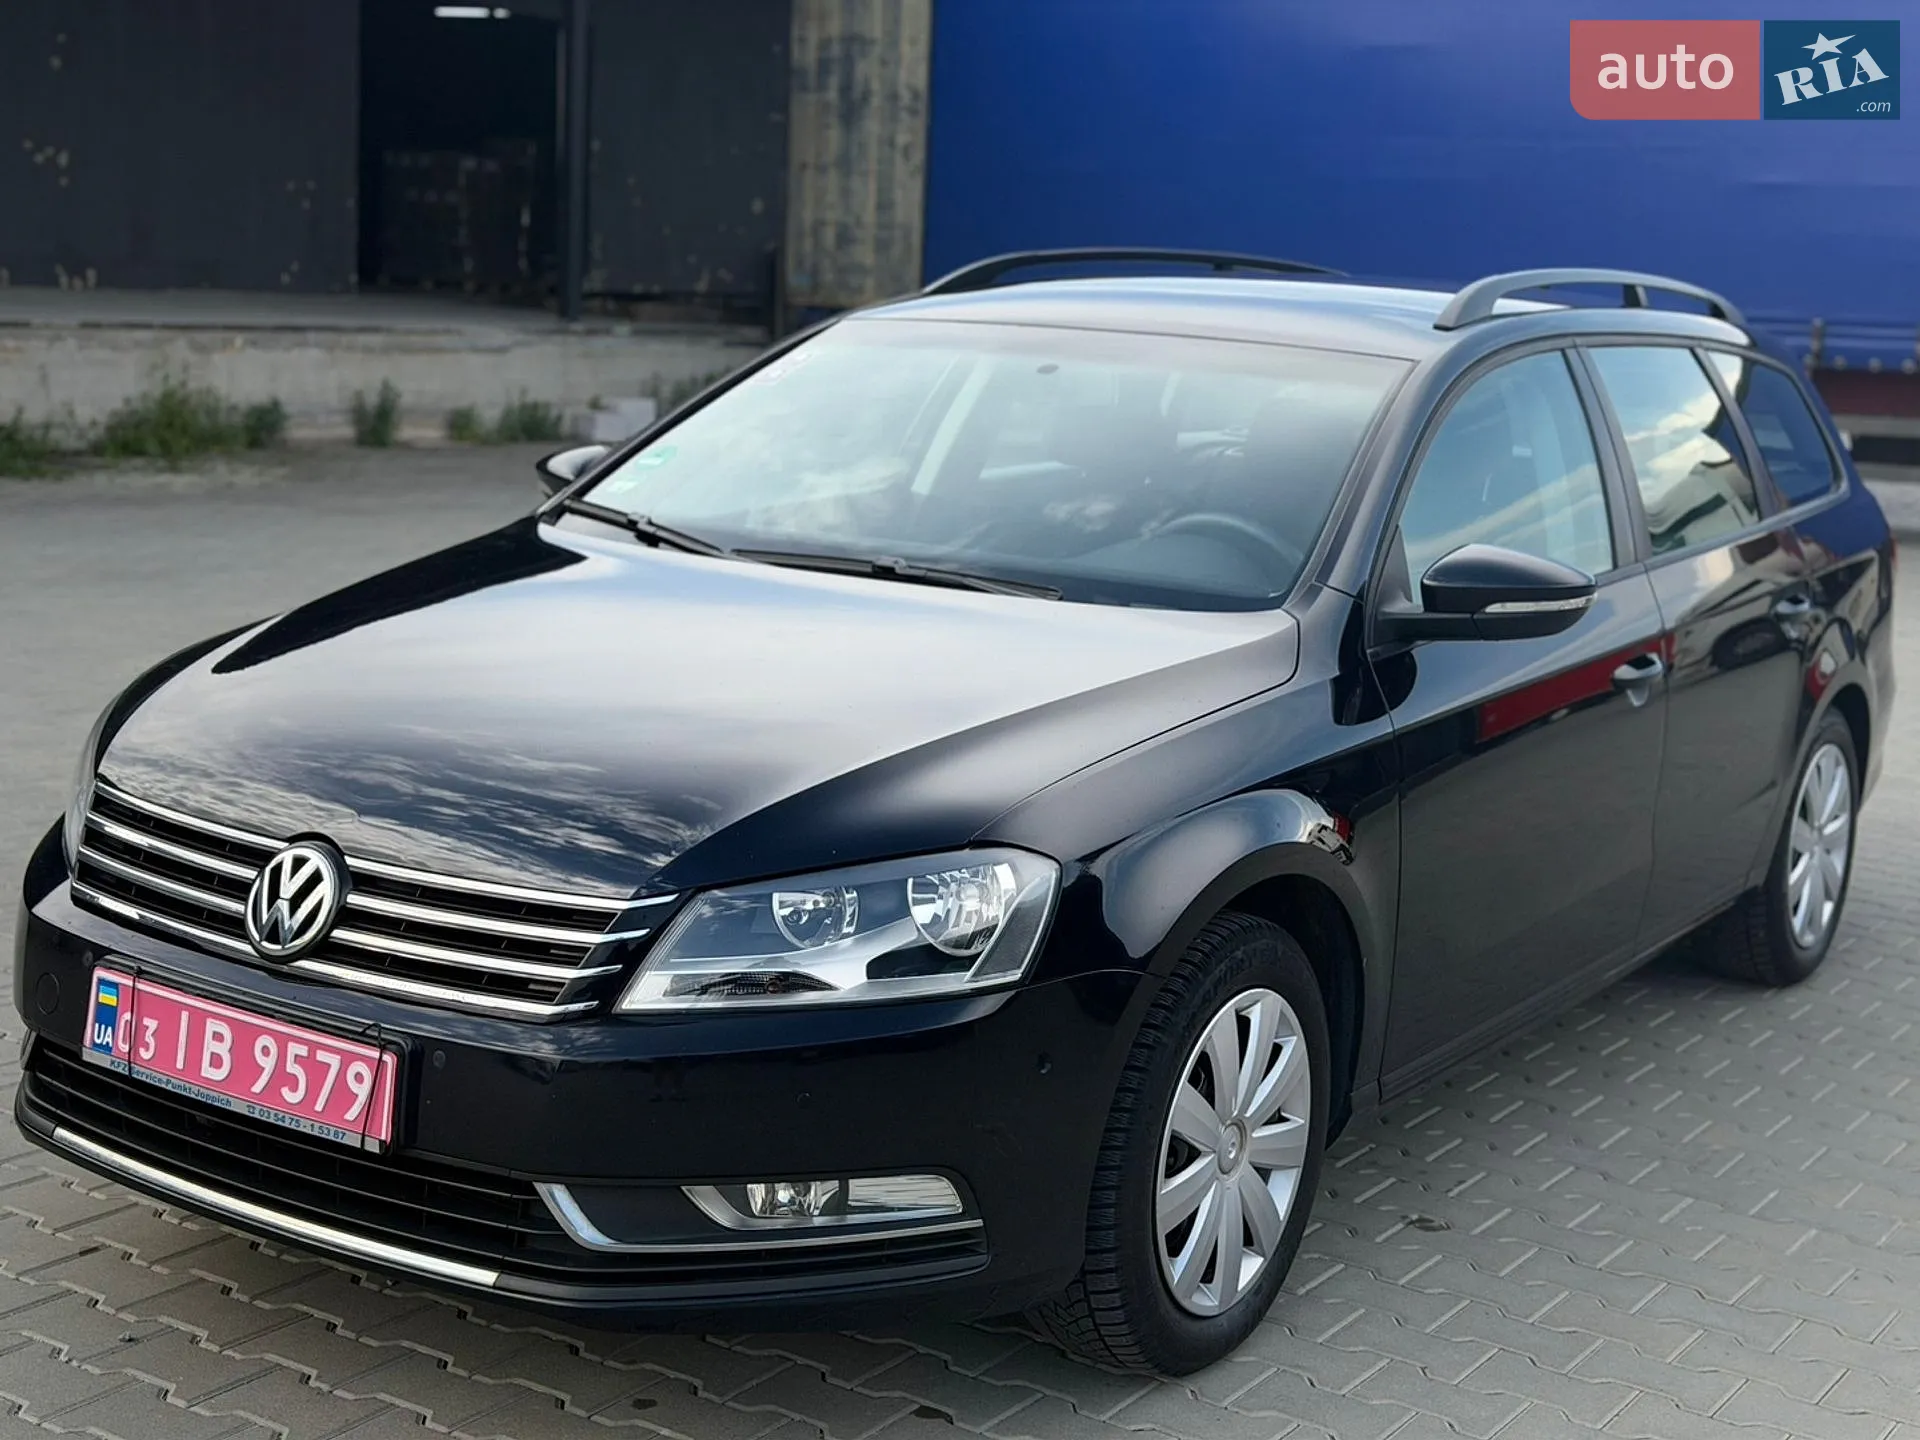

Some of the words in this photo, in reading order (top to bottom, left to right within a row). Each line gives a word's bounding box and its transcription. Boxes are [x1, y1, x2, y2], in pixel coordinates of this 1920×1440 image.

[94, 1022, 113, 1048] UA
[175, 1011, 234, 1082] IB
[250, 1034, 372, 1122] 9579
